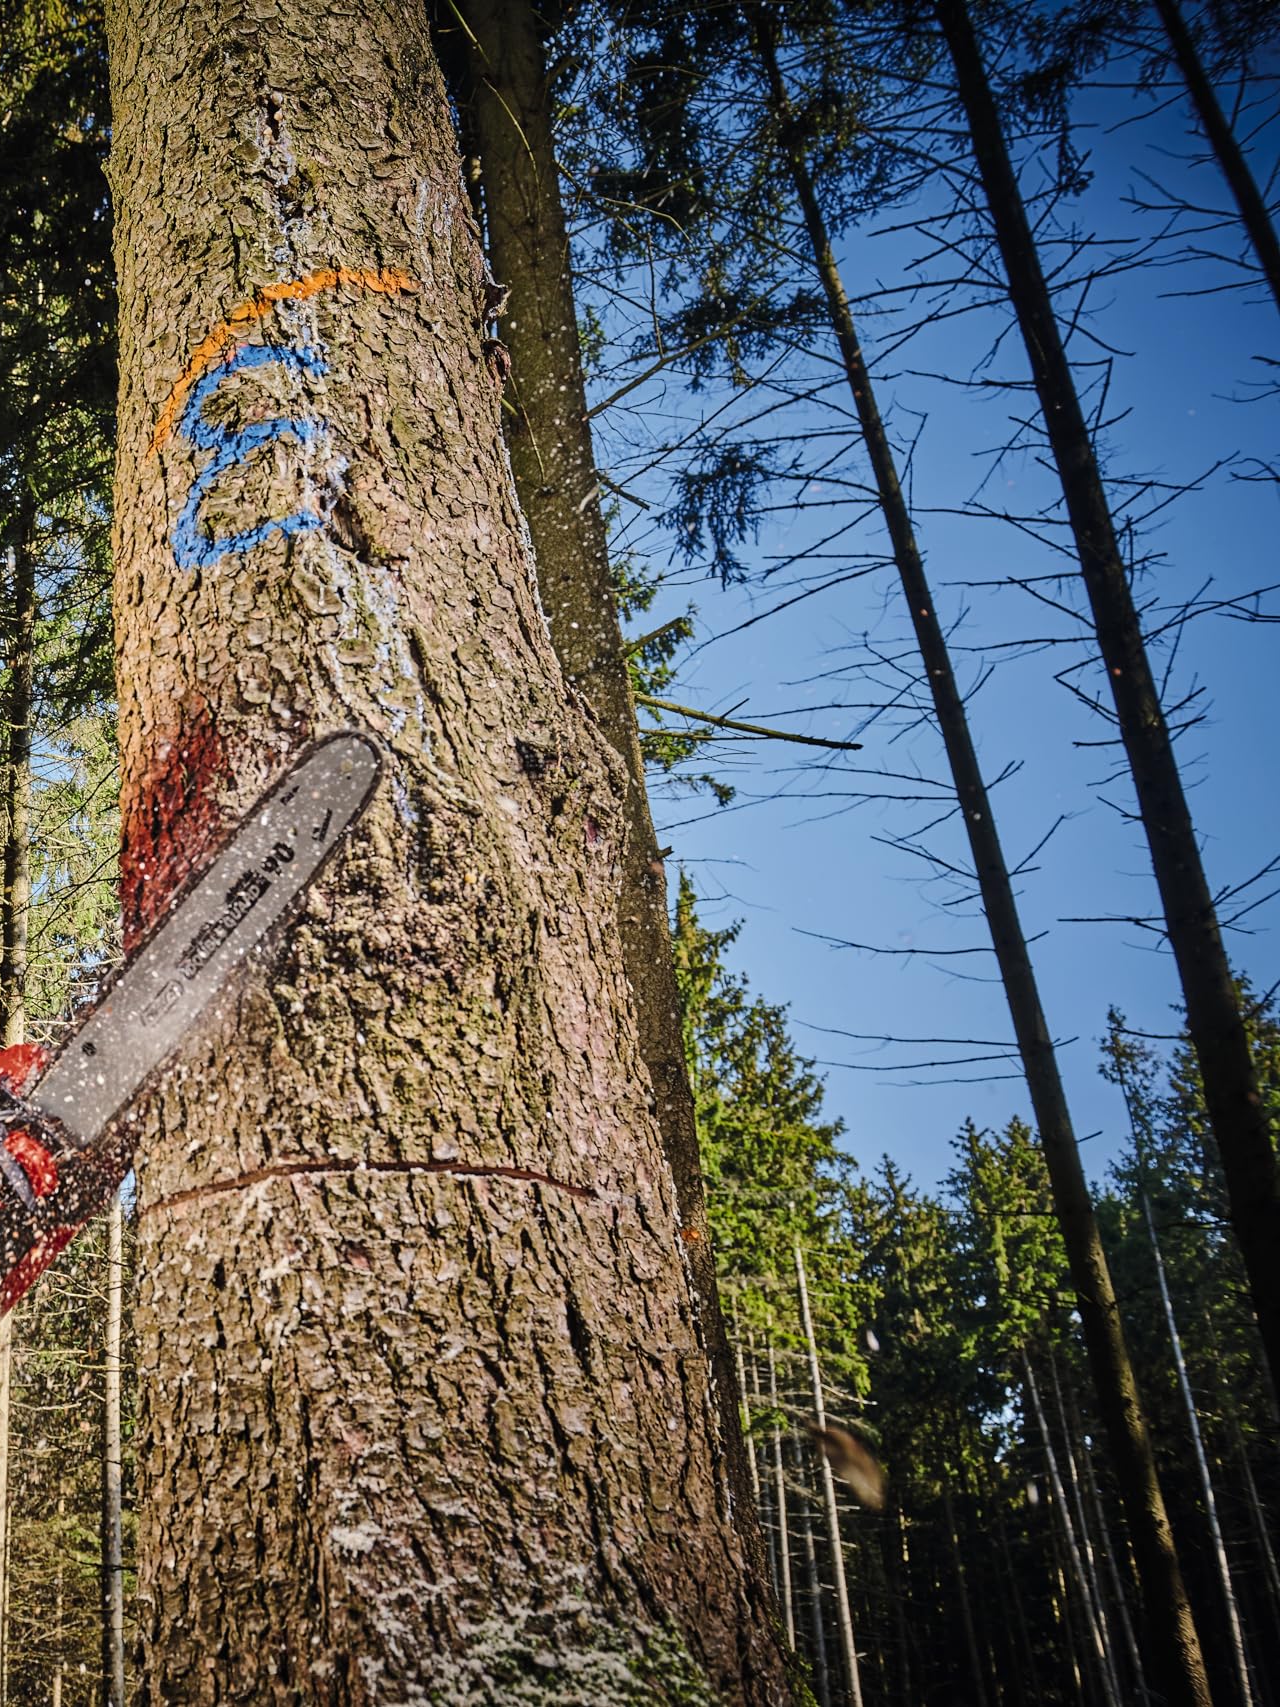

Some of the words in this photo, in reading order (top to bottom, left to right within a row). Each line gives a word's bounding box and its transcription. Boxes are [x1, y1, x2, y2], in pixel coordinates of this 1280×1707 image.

[182, 923, 228, 976] DOUBLE
[222, 884, 261, 928] GUARD
[260, 842, 295, 876] 90
